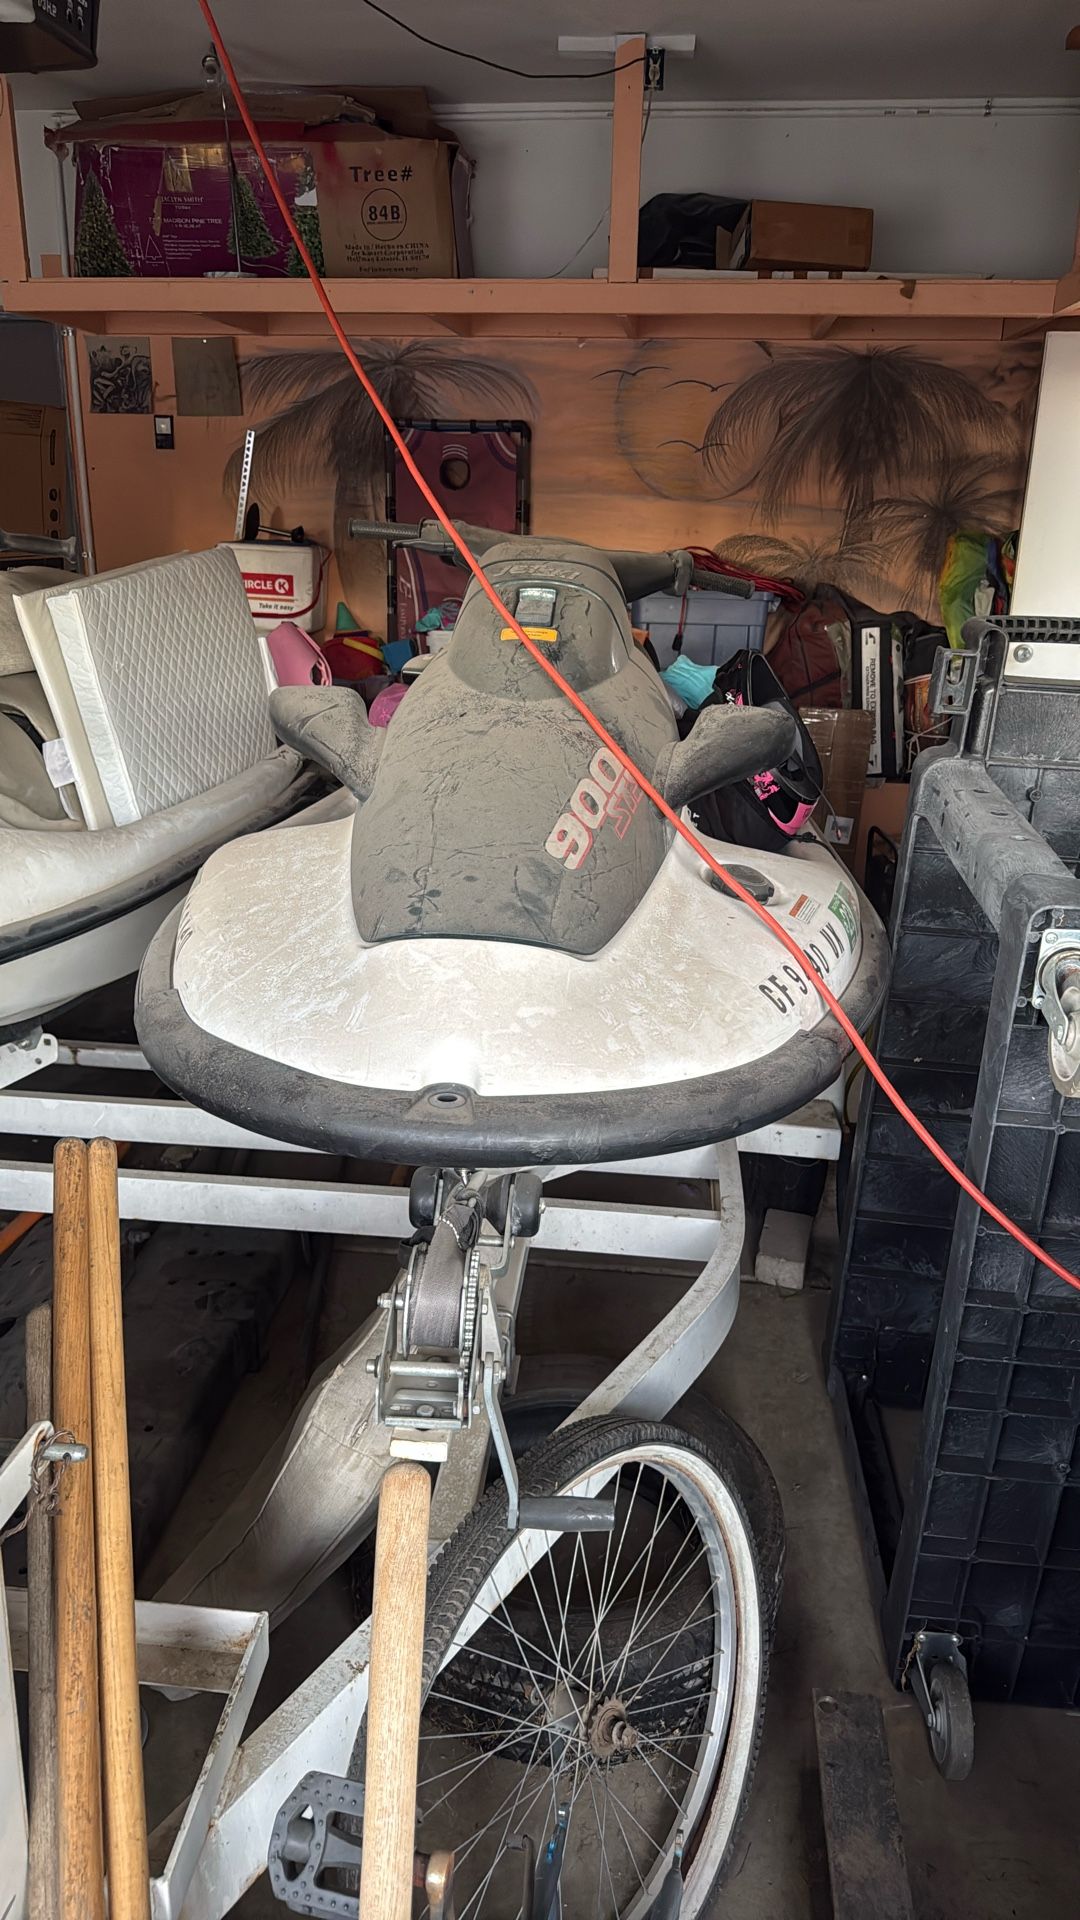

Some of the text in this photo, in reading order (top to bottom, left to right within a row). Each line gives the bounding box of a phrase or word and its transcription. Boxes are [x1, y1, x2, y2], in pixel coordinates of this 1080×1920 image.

[348, 165, 413, 182] Tree#
[368, 205, 400, 221] 84B
[243, 578, 289, 593] IRCLE K
[870, 692, 877, 700] TO
[544, 746, 626, 870] 900
[758, 975, 795, 1014] CF
